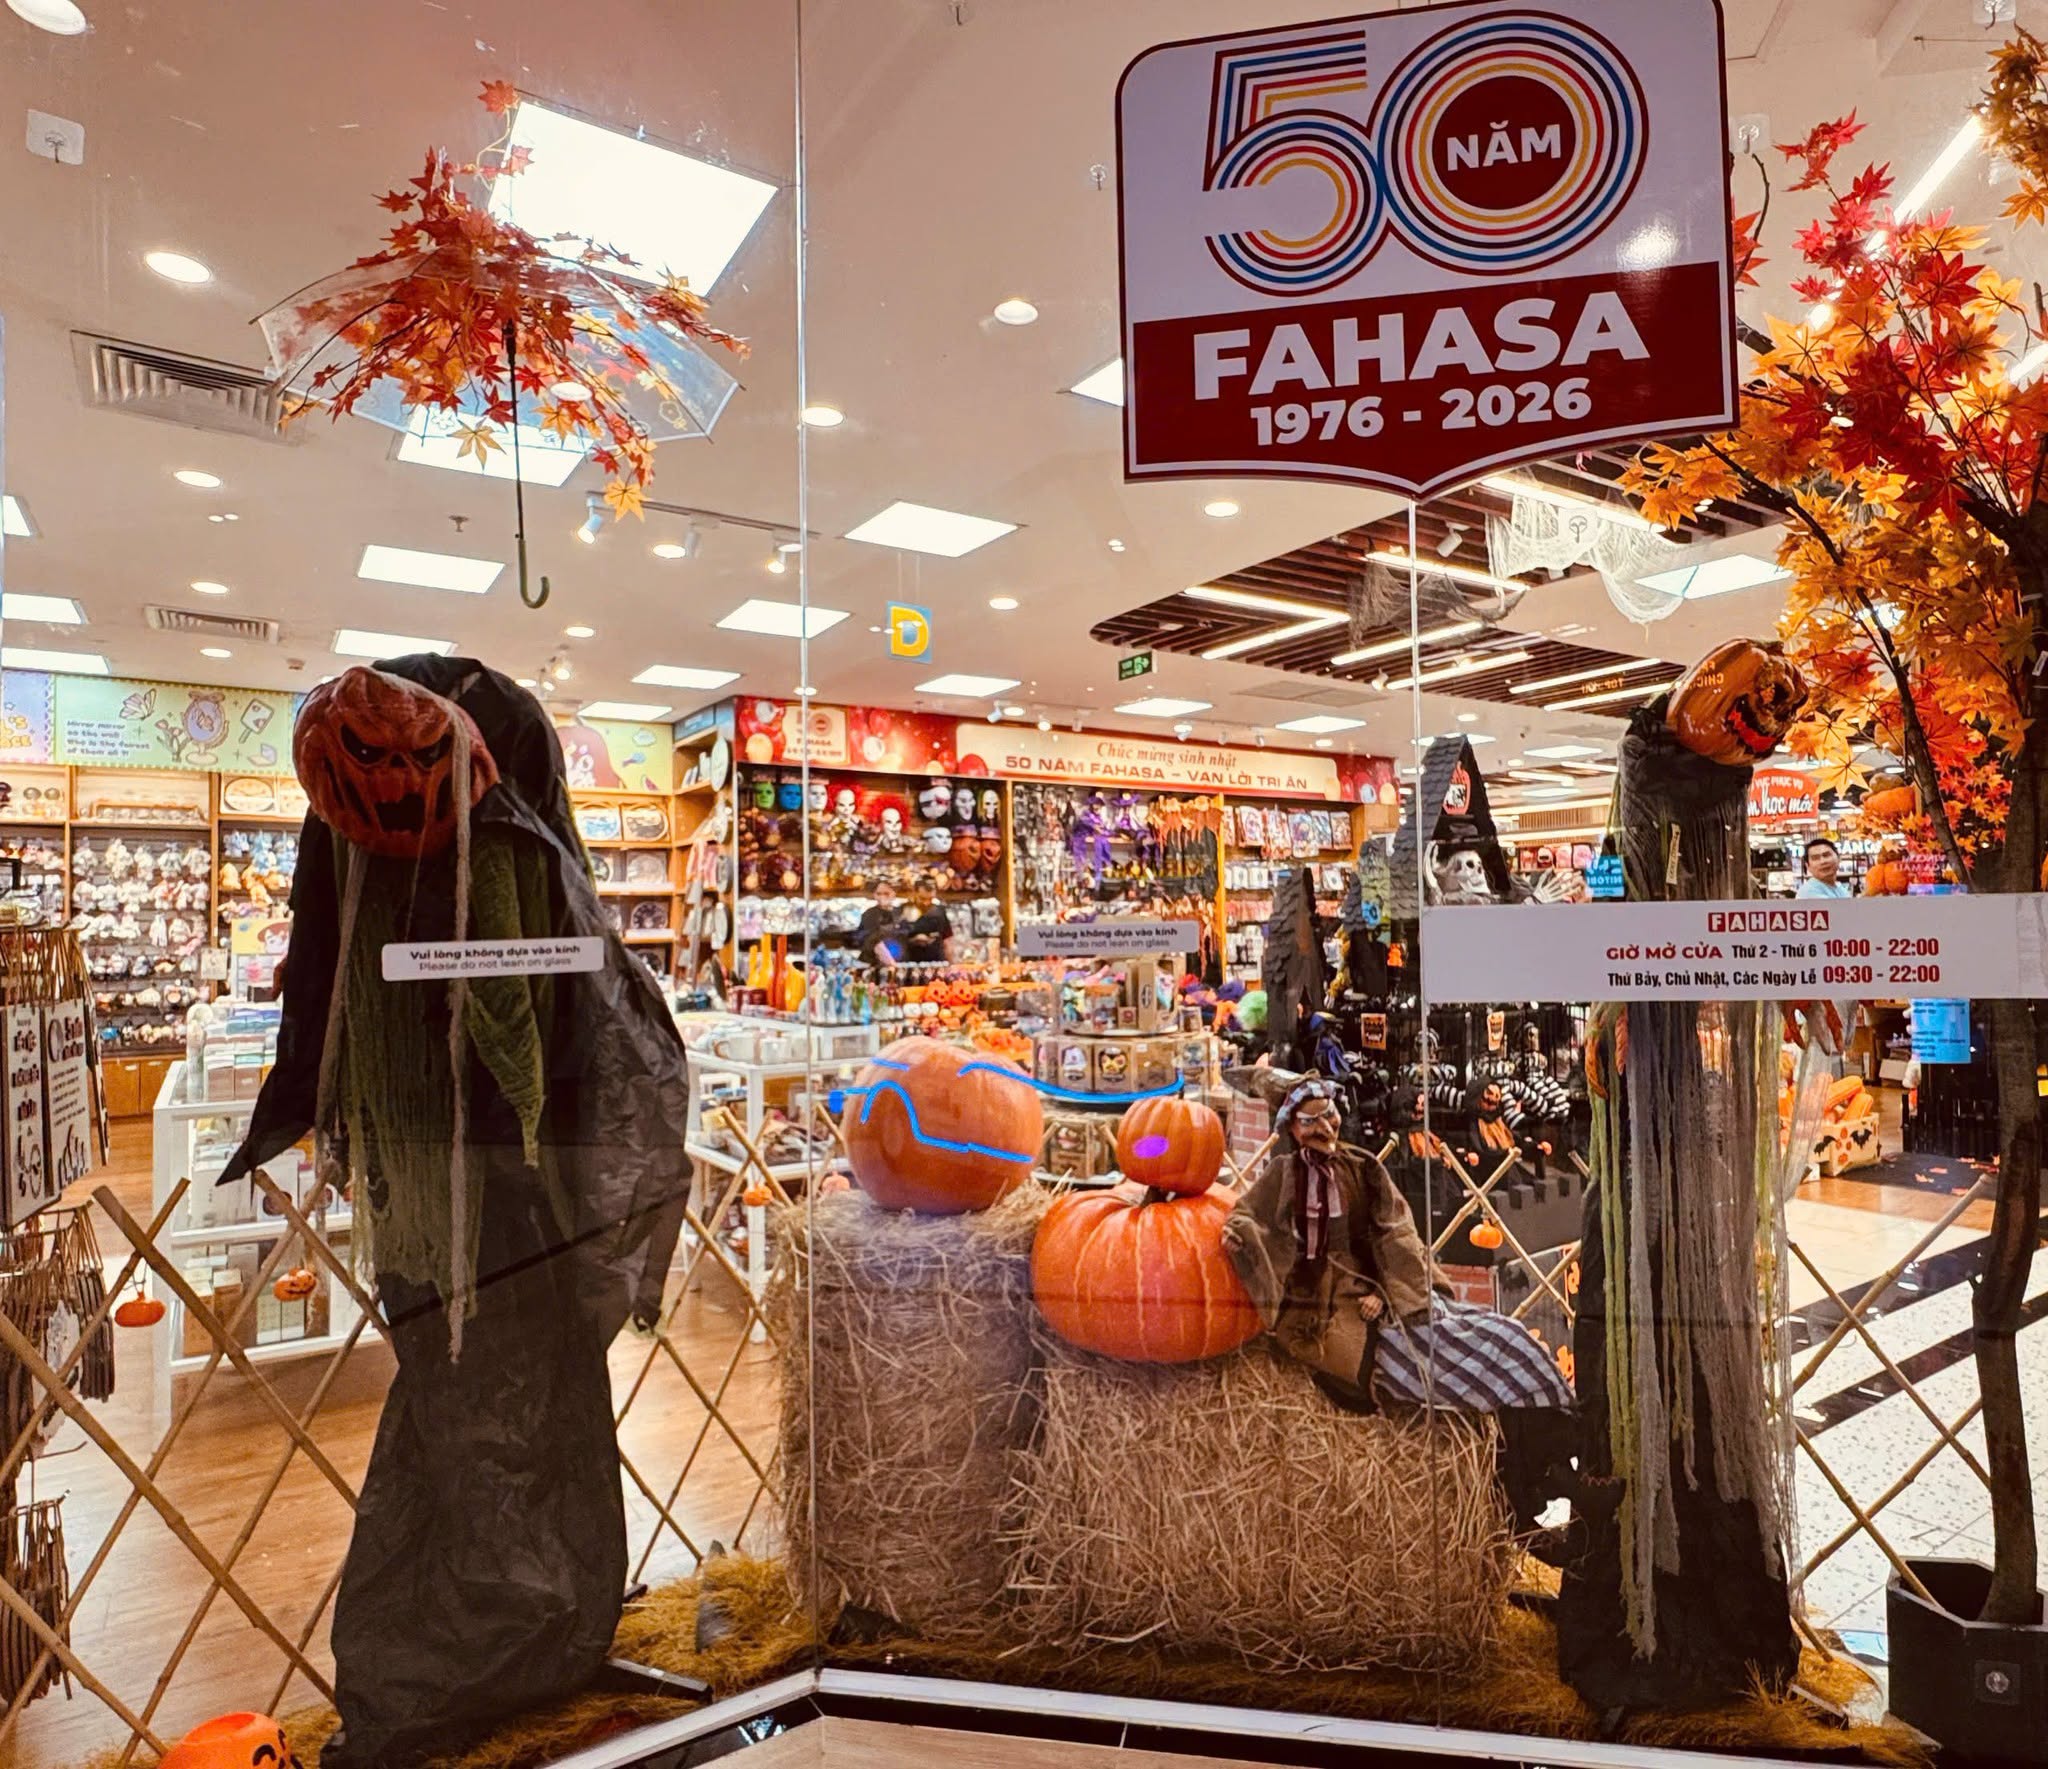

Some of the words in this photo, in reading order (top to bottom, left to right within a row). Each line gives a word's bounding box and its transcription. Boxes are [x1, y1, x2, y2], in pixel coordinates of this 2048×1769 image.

[1202, 9, 1649, 298] 50
[1447, 121, 1562, 172] NĂM
[1193, 290, 1651, 401] FAHASA
[1250, 396, 1384, 447] 1976
[1403, 410, 1420, 421] -
[1440, 378, 1592, 430] 2026
[891, 606, 928, 657] D
[1097, 741, 1133, 760] Chúc
[1137, 745, 1175, 766] mừng
[1179, 749, 1205, 766] sinh
[1209, 751, 1237, 771] nhật
[1005, 756, 1031, 770] 50
[1090, 762, 1165, 780] FAHASA
[1258, 775, 1281, 788] TRI
[1038, 931, 1053, 939] Vui
[1056, 930, 1078, 939] lòng
[1080, 929, 1112, 938] không
[1114, 929, 1133, 938] dựa
[1135, 928, 1153, 937] vào
[1155, 927, 1178, 936] kính
[1709, 911, 1830, 932] FAHASA
[410, 951, 430, 960] Vui
[433, 949, 461, 960] lòng
[465, 947, 503, 958] không
[507, 946, 528, 957] dựa
[532, 945, 552, 955] vào
[555, 945, 581, 954] kính
[1045, 940, 1074, 949] Please
[1078, 940, 1089, 948] do
[1091, 940, 1107, 948] not
[1109, 938, 1128, 947] lean
[1146, 938, 1170, 948] glass
[1606, 944, 1640, 960] GIỜ
[1646, 942, 1677, 960] MỞ
[1681, 941, 1723, 959] CỬA
[1732, 944, 1756, 959] Thứ
[1759, 945, 1768, 958] 2
[1781, 943, 1806, 958] Thứ
[1808, 944, 1817, 957] 6
[1823, 939, 1871, 957] 10:00
[1888, 938, 1940, 957] 22:00
[419, 961, 457, 971] Please
[461, 961, 476, 969] do
[479, 960, 498, 969] not
[501, 958, 525, 968] lean
[528, 959, 541, 967] on
[544, 957, 572, 967] glass
[1608, 972, 1632, 986] Thứ
[1635, 971, 1661, 988] Bảy,
[1665, 970, 1690, 986] Chủ
[1694, 971, 1729, 989] Nhật,
[1733, 970, 1758, 986] Các
[1763, 970, 1797, 987] Ngày
[1801, 968, 1817, 985] Lễ
[1823, 965, 1873, 984] 09:30
[1889, 964, 1940, 983] 22:00
